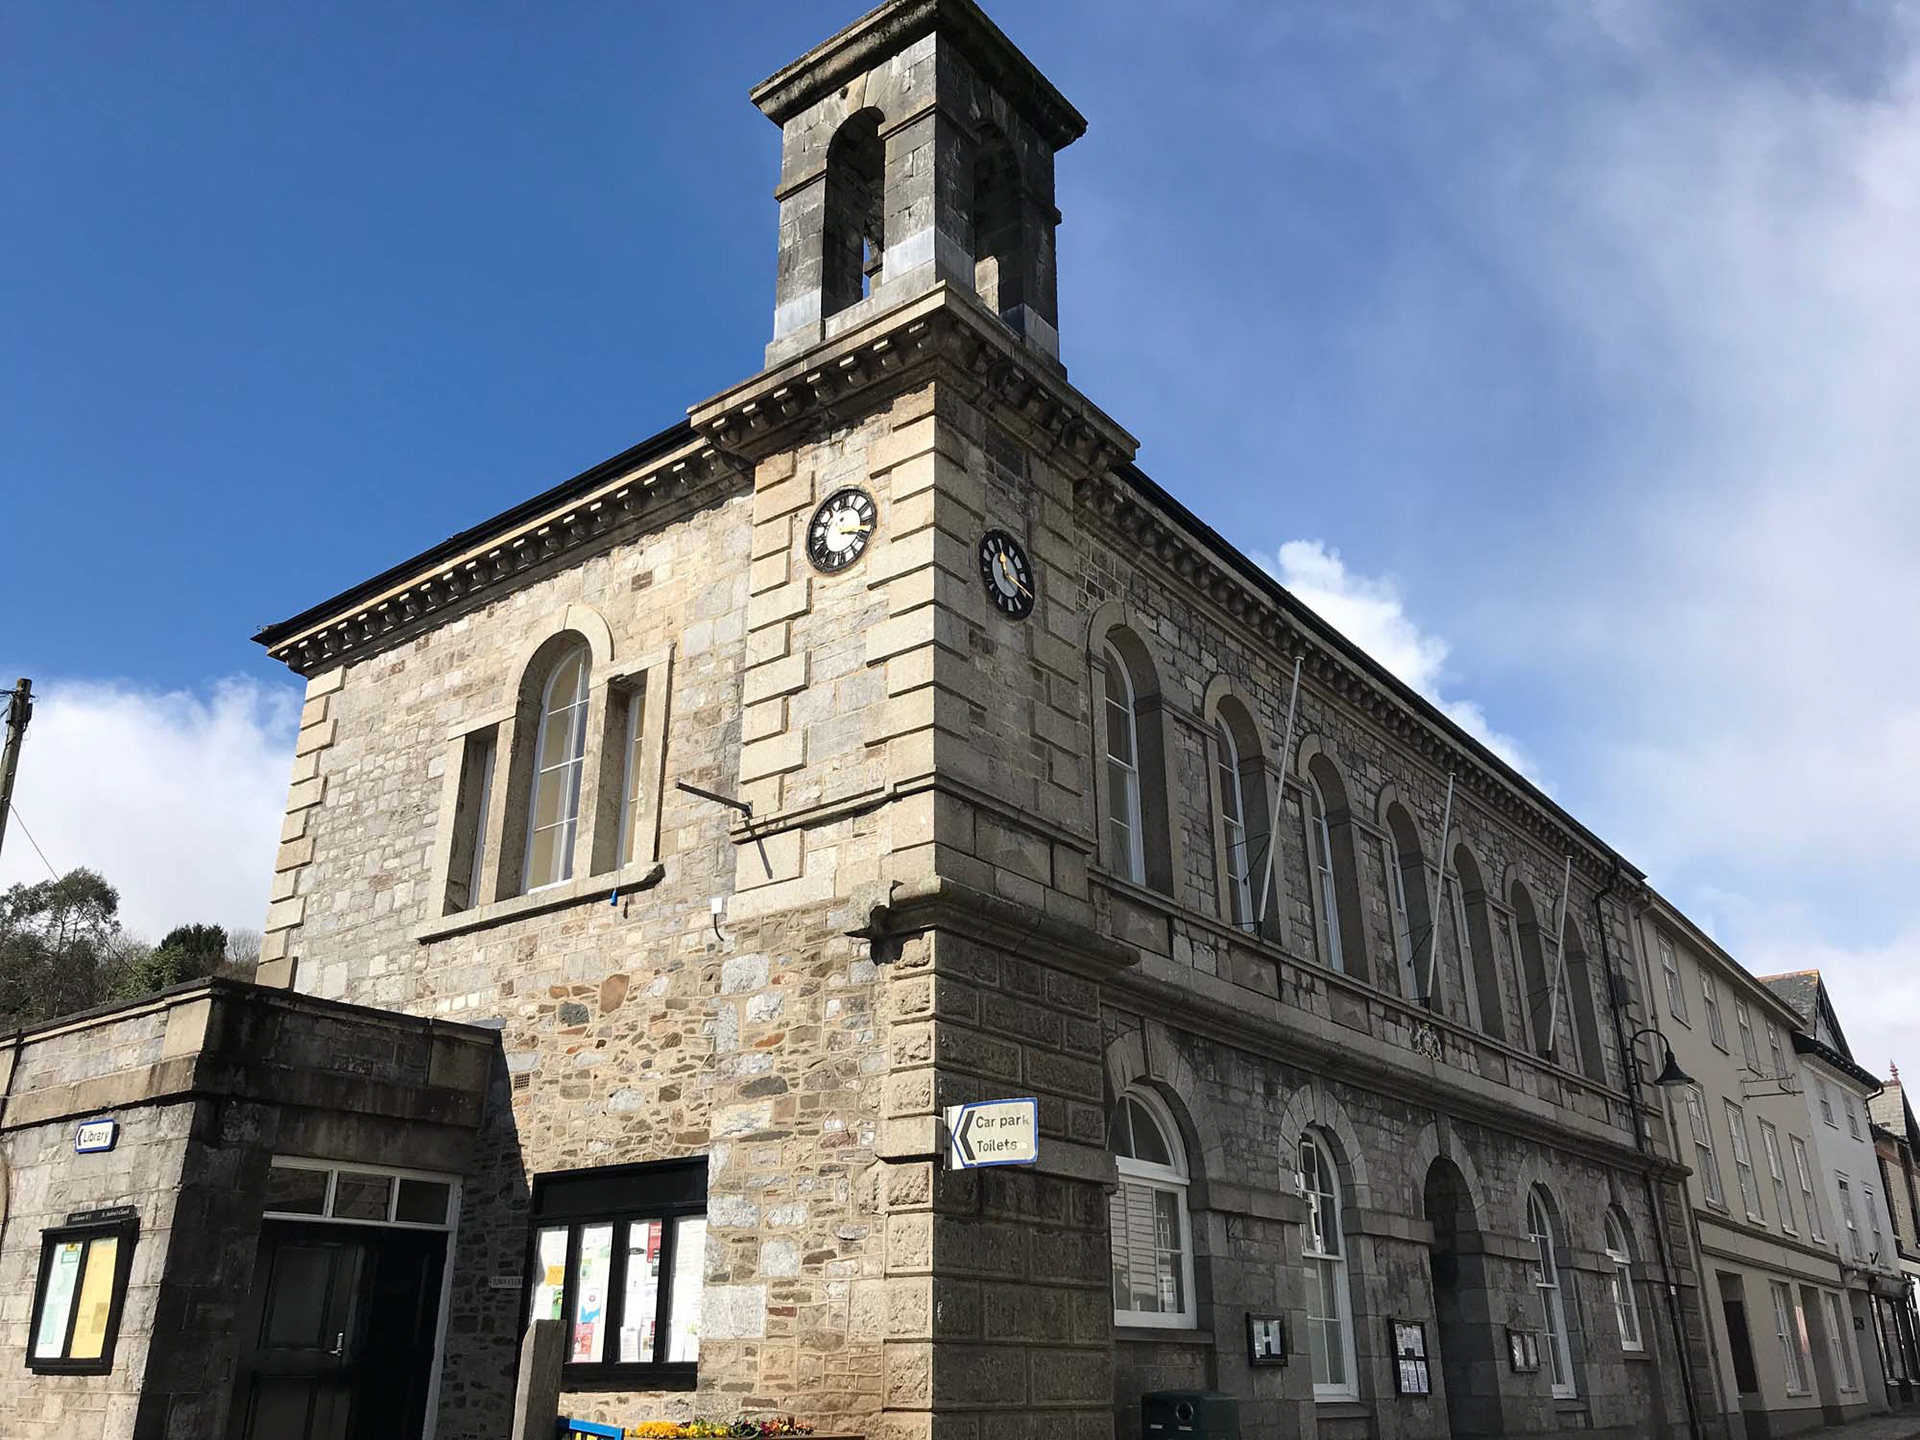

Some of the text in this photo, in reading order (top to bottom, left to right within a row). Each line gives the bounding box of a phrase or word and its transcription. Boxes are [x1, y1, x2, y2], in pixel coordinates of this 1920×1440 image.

[976, 1114, 1030, 1128] Car park
[83, 1130, 110, 1143] Library
[976, 1138, 1018, 1152] Toilets
